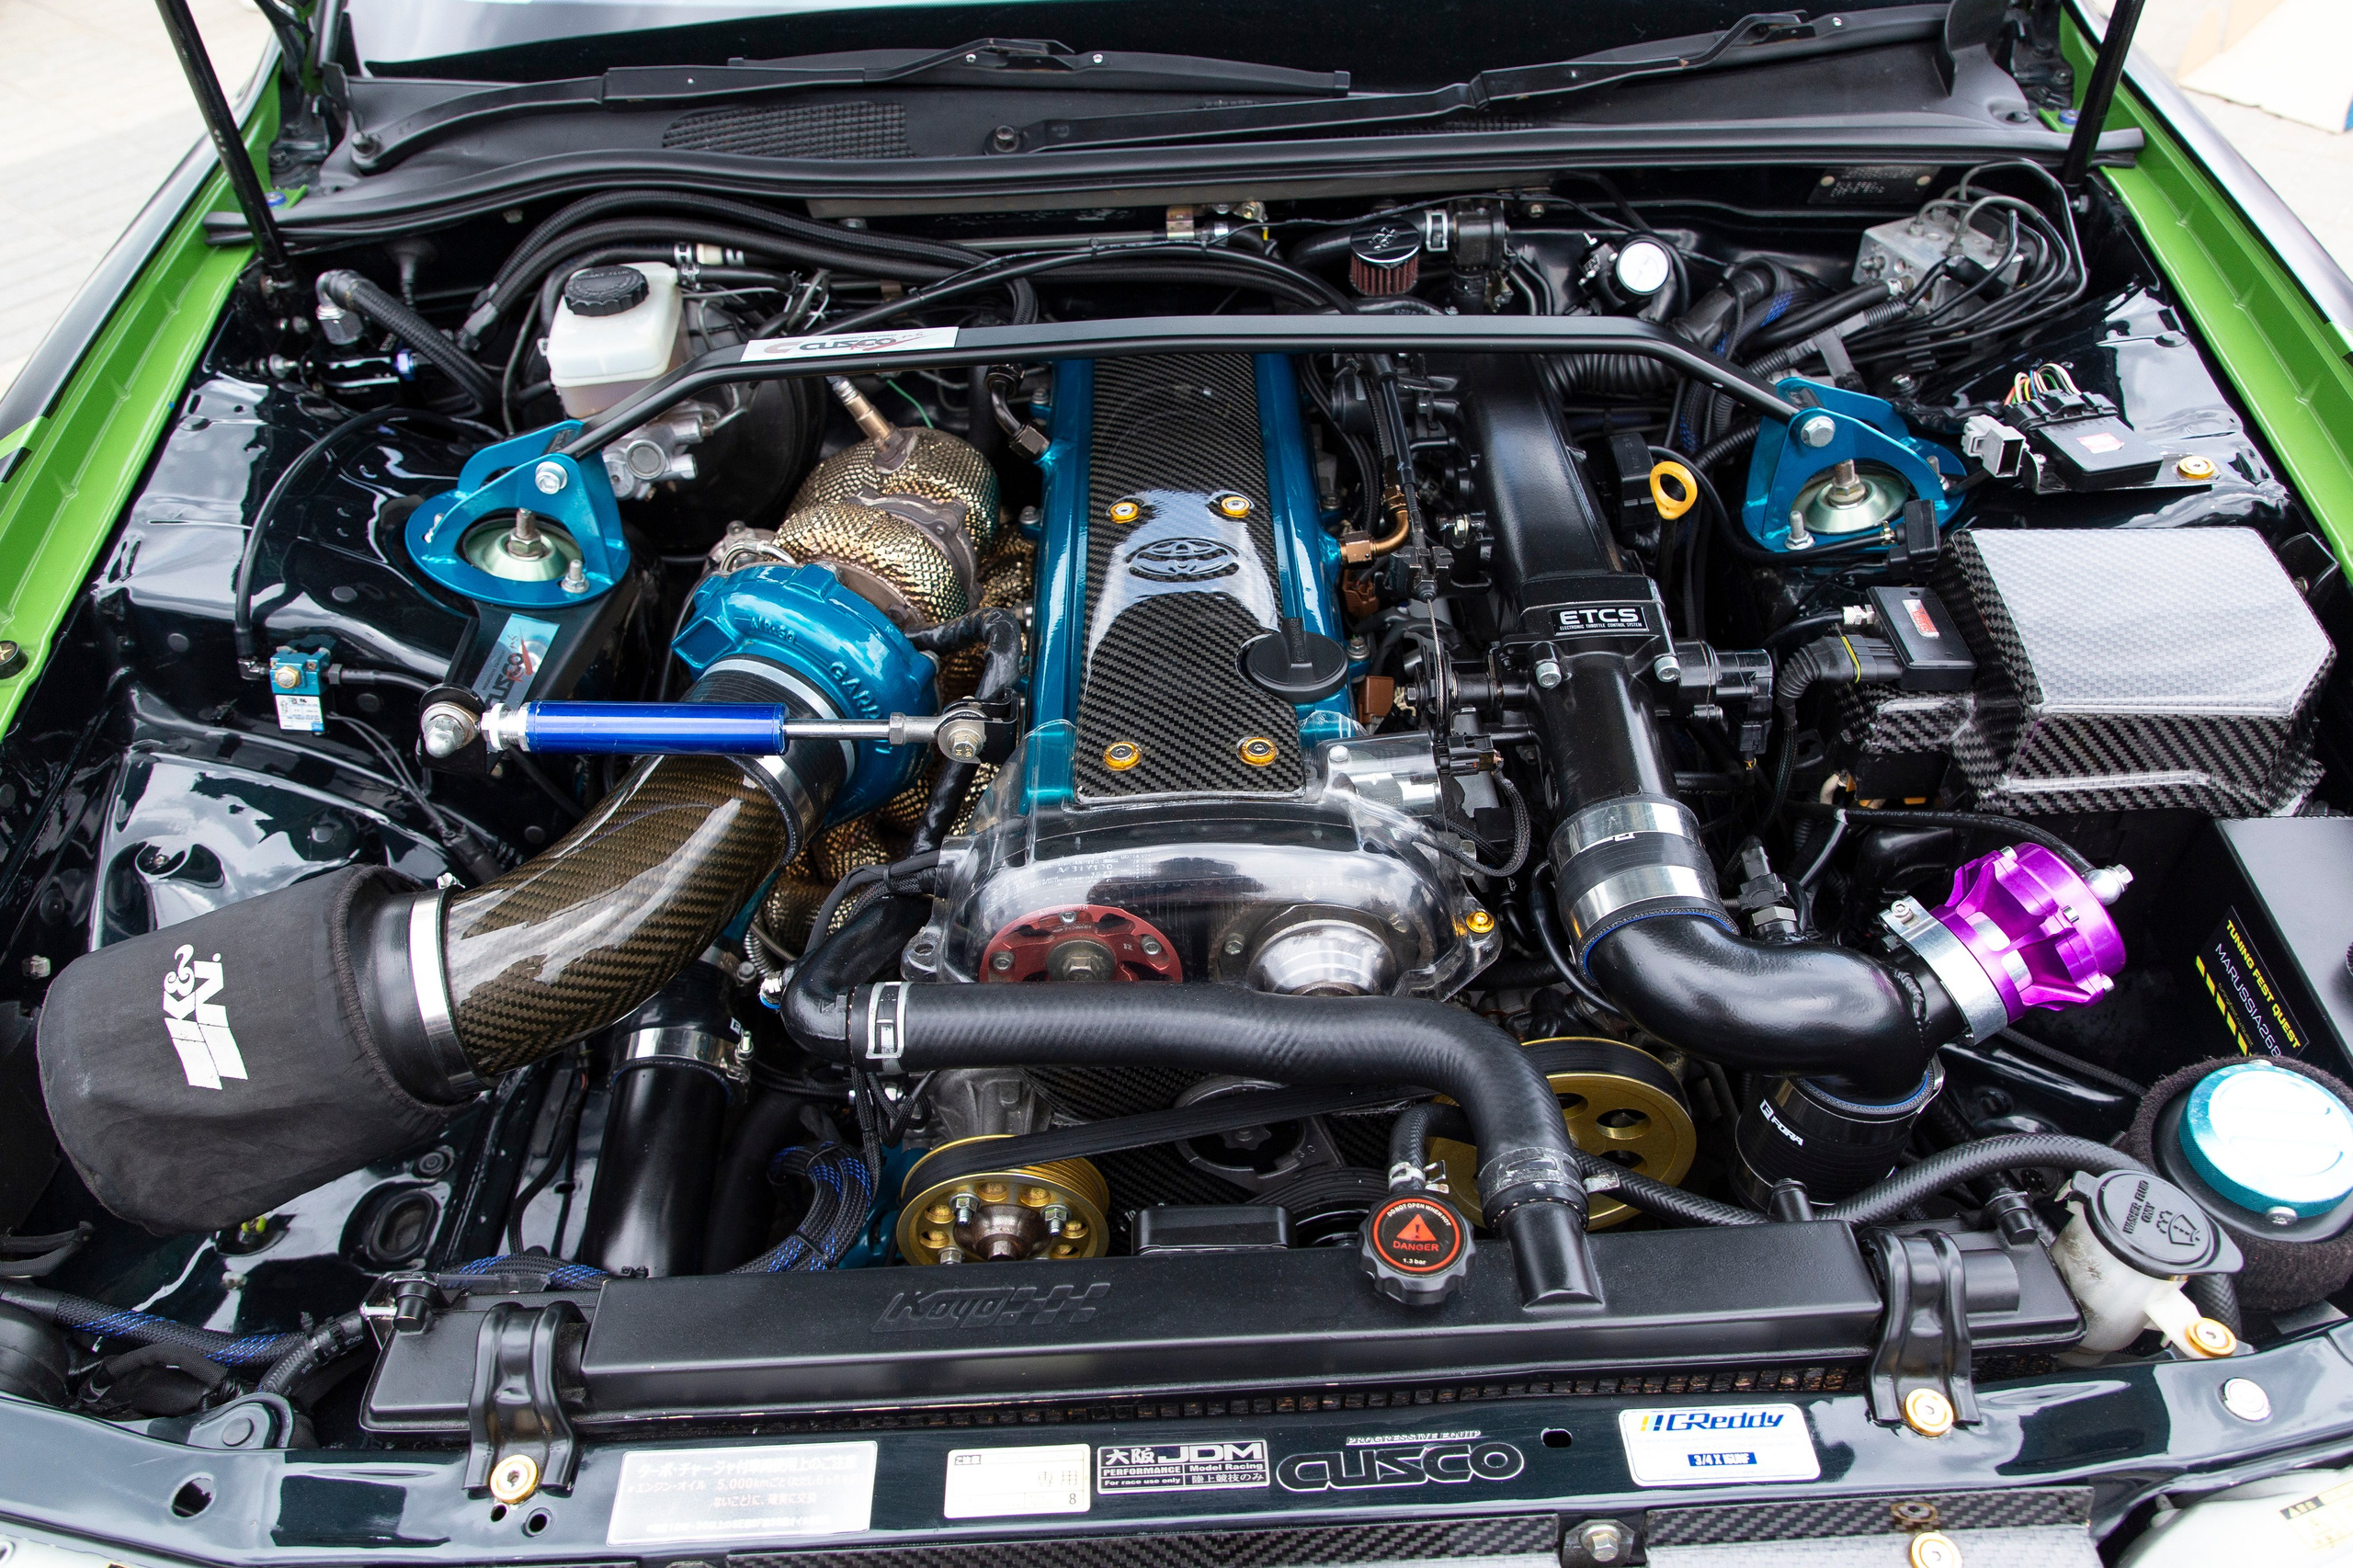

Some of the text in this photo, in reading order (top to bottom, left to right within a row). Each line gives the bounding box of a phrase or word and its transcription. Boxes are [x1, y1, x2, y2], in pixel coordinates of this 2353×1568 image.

[799, 337, 897, 352] CUSCO
[1559, 608, 1639, 625] ETCS
[2225, 919, 2302, 1049] TUNING FEST QUEST
[2215, 943, 2281, 1057] MARUSSIA268
[1386, 1209, 1396, 1218] DO
[1394, 1203, 1407, 1213] NOT
[1425, 1204, 1443, 1217] WHEN
[1440, 1214, 1452, 1227] HOT
[2122, 1179, 2150, 1234] WASHER FLUID
[2141, 1201, 2156, 1223] ONLY
[1392, 1240, 1440, 1252] DANGER
[1665, 1411, 1785, 1431] GReddy
[1346, 1429, 1482, 1446] PROGRESSIVE EQUIP
[1105, 1442, 1264, 1466] 大阪 JDM
[1103, 1466, 1181, 1477] PERFORMANCE
[1189, 1463, 1264, 1472] Model Racing
[1276, 1441, 1525, 1493] CUSCO
[1162, 1476, 1181, 1484] only
[1069, 1493, 1076, 1505] 8
